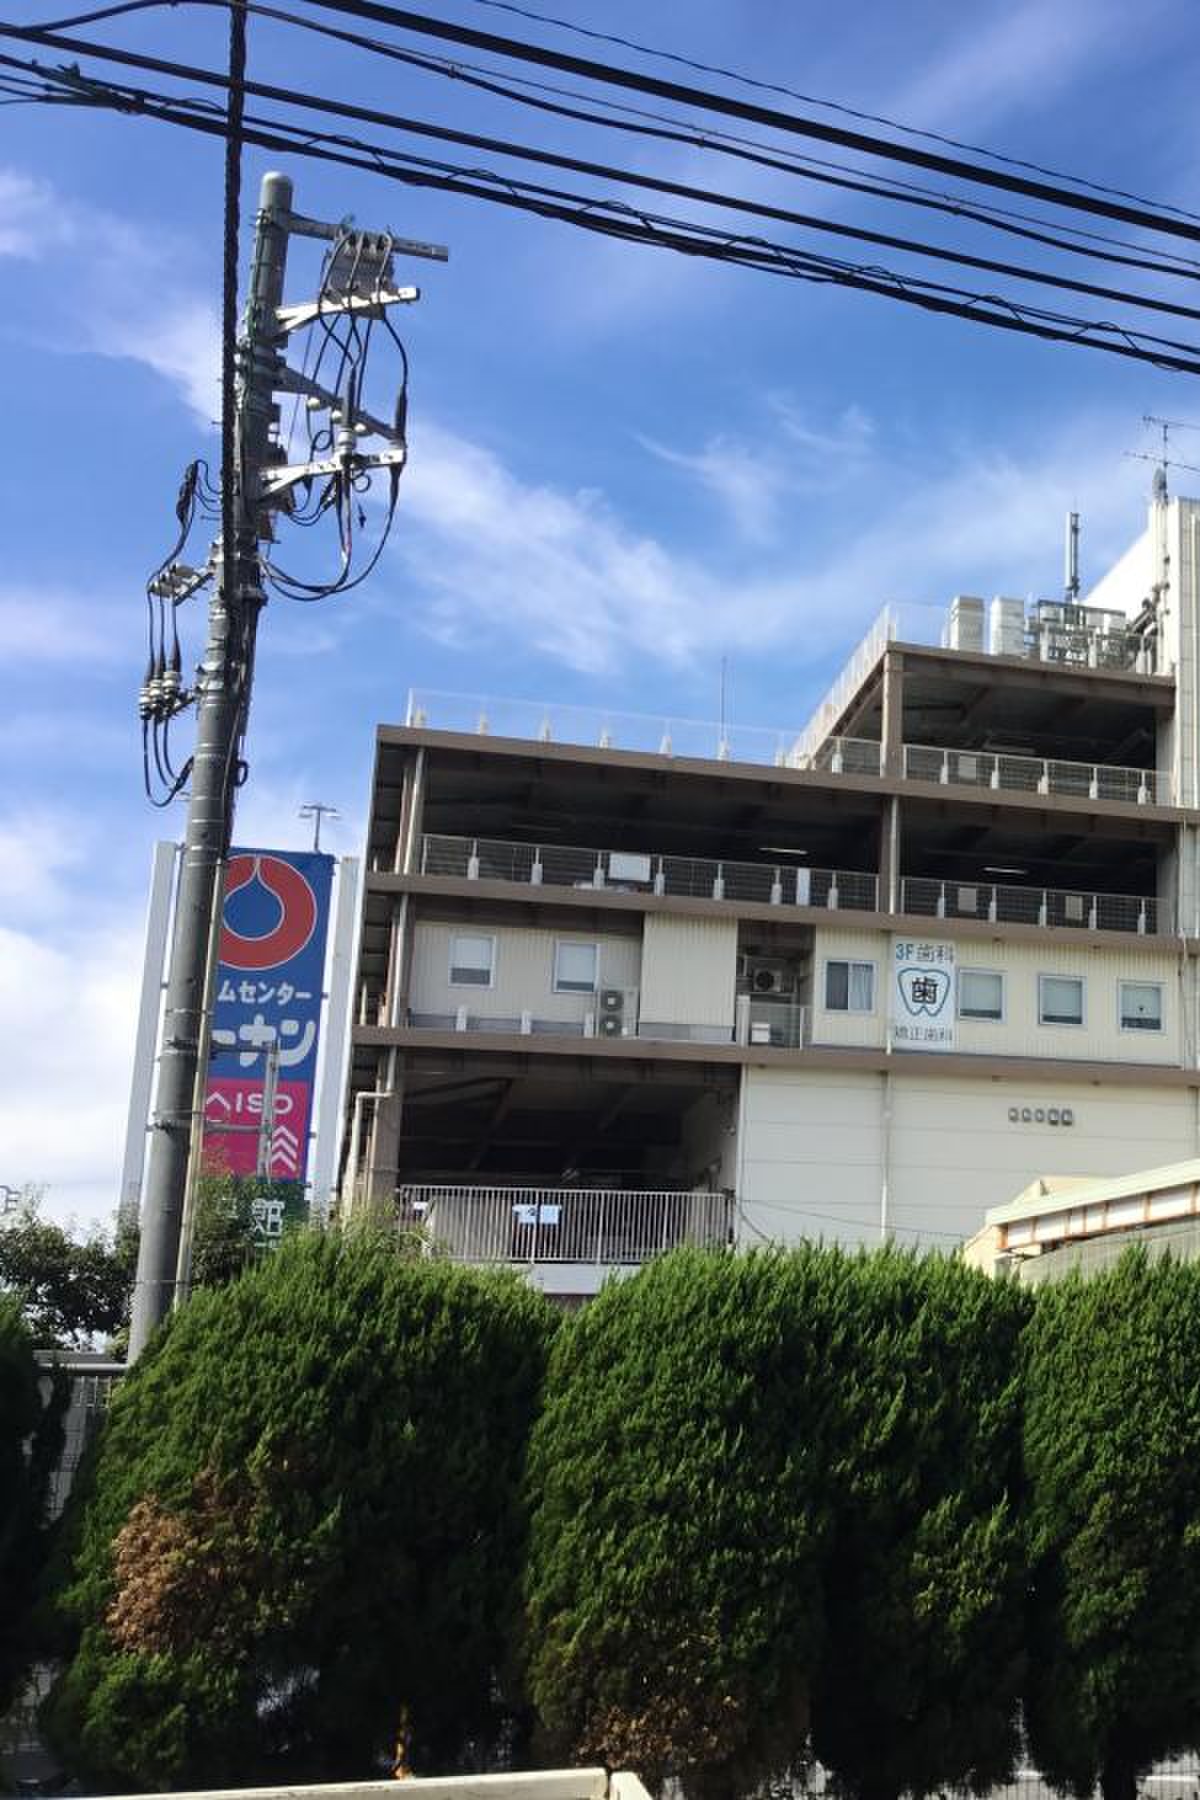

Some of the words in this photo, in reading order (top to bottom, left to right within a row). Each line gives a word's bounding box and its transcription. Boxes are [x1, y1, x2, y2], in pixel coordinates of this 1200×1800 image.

[217, 980, 312, 1006] ムセンター
[911, 976, 939, 1005] 歯
[211, 1013, 317, 1068] ーナン
